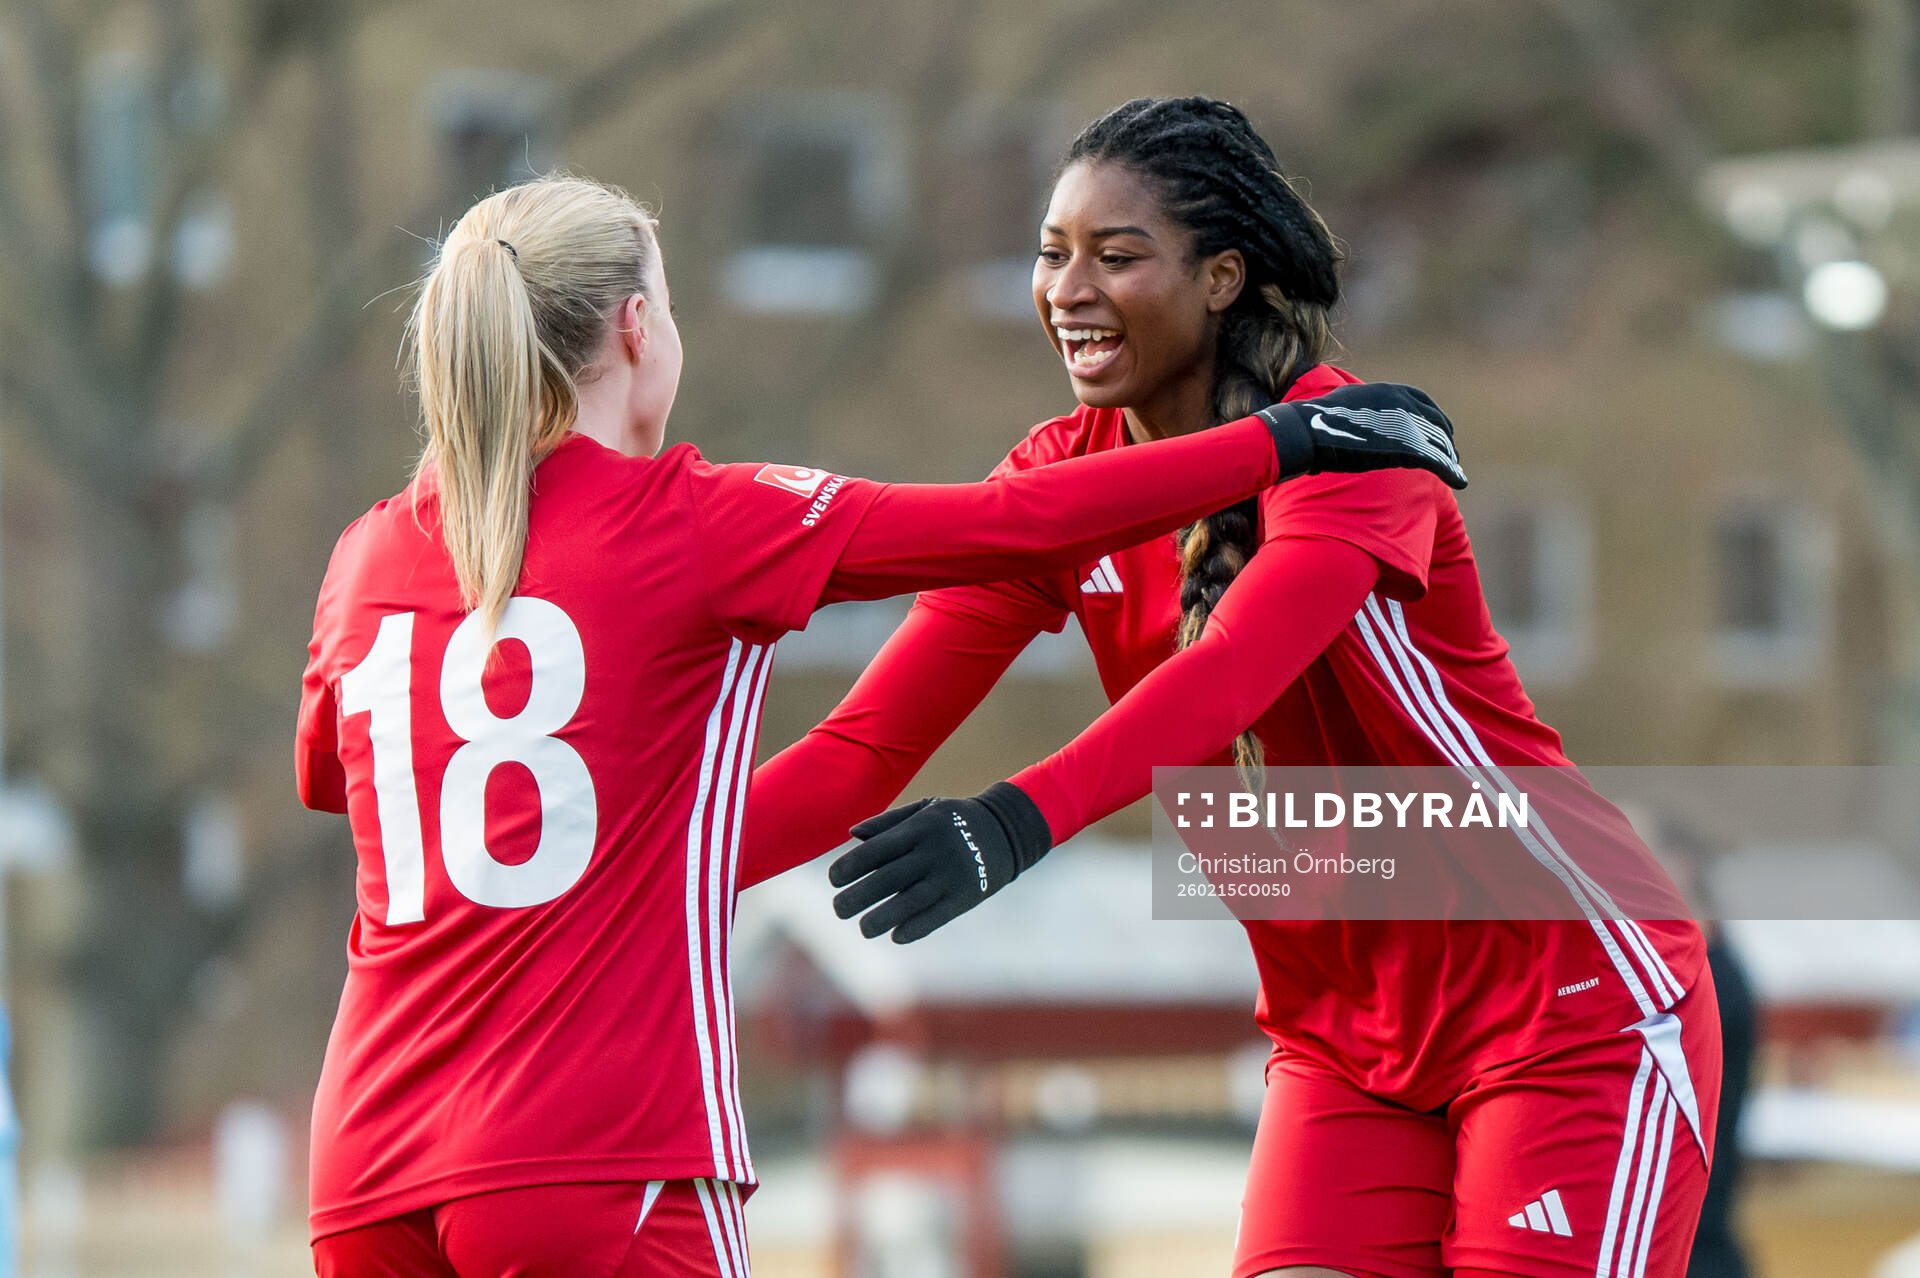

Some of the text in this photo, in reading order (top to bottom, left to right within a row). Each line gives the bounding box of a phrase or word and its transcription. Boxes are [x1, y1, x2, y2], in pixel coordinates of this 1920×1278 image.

[340, 596, 597, 926] 18
[960, 829, 988, 892] CRAFT
[1557, 977, 1600, 997] AEROREADY
